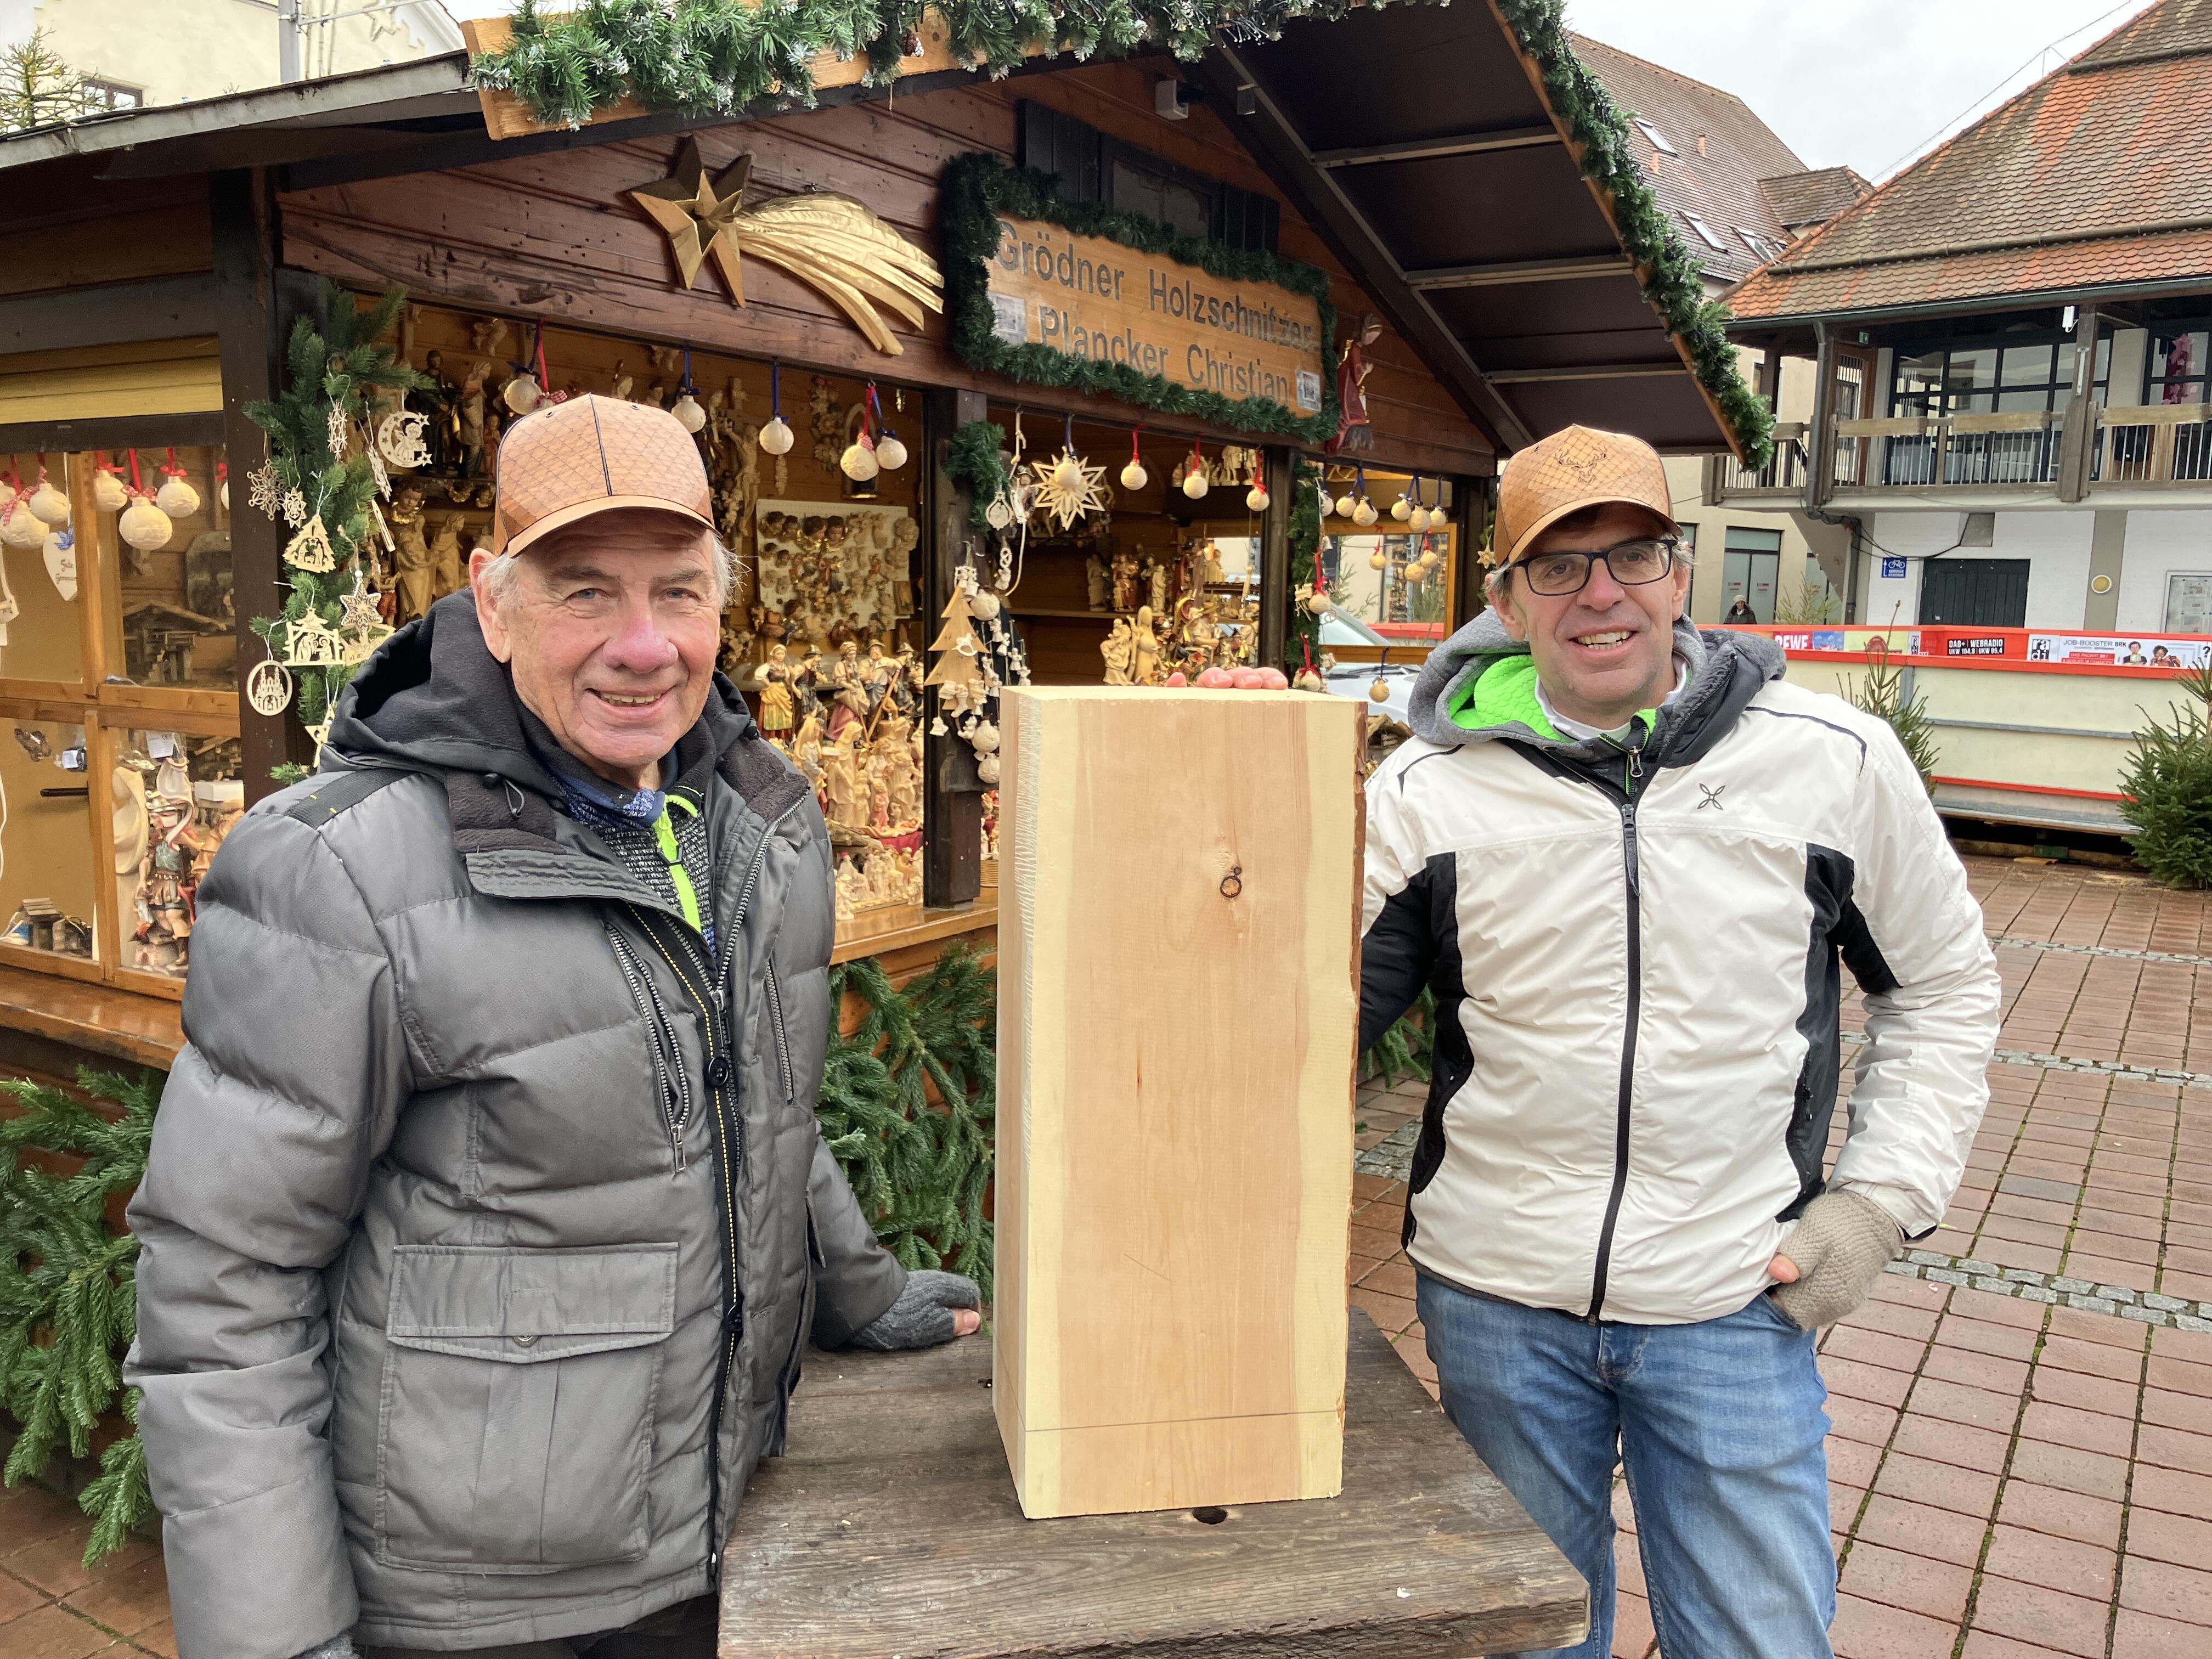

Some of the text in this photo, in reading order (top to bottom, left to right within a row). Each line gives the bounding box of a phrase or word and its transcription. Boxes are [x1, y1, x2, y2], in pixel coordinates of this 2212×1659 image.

[996, 220, 1313, 352] Grödner Holzschnitzer
[1039, 306, 1289, 404] Plancker Christian
[1949, 639, 2003, 648] DAB+ WEBRADIO
